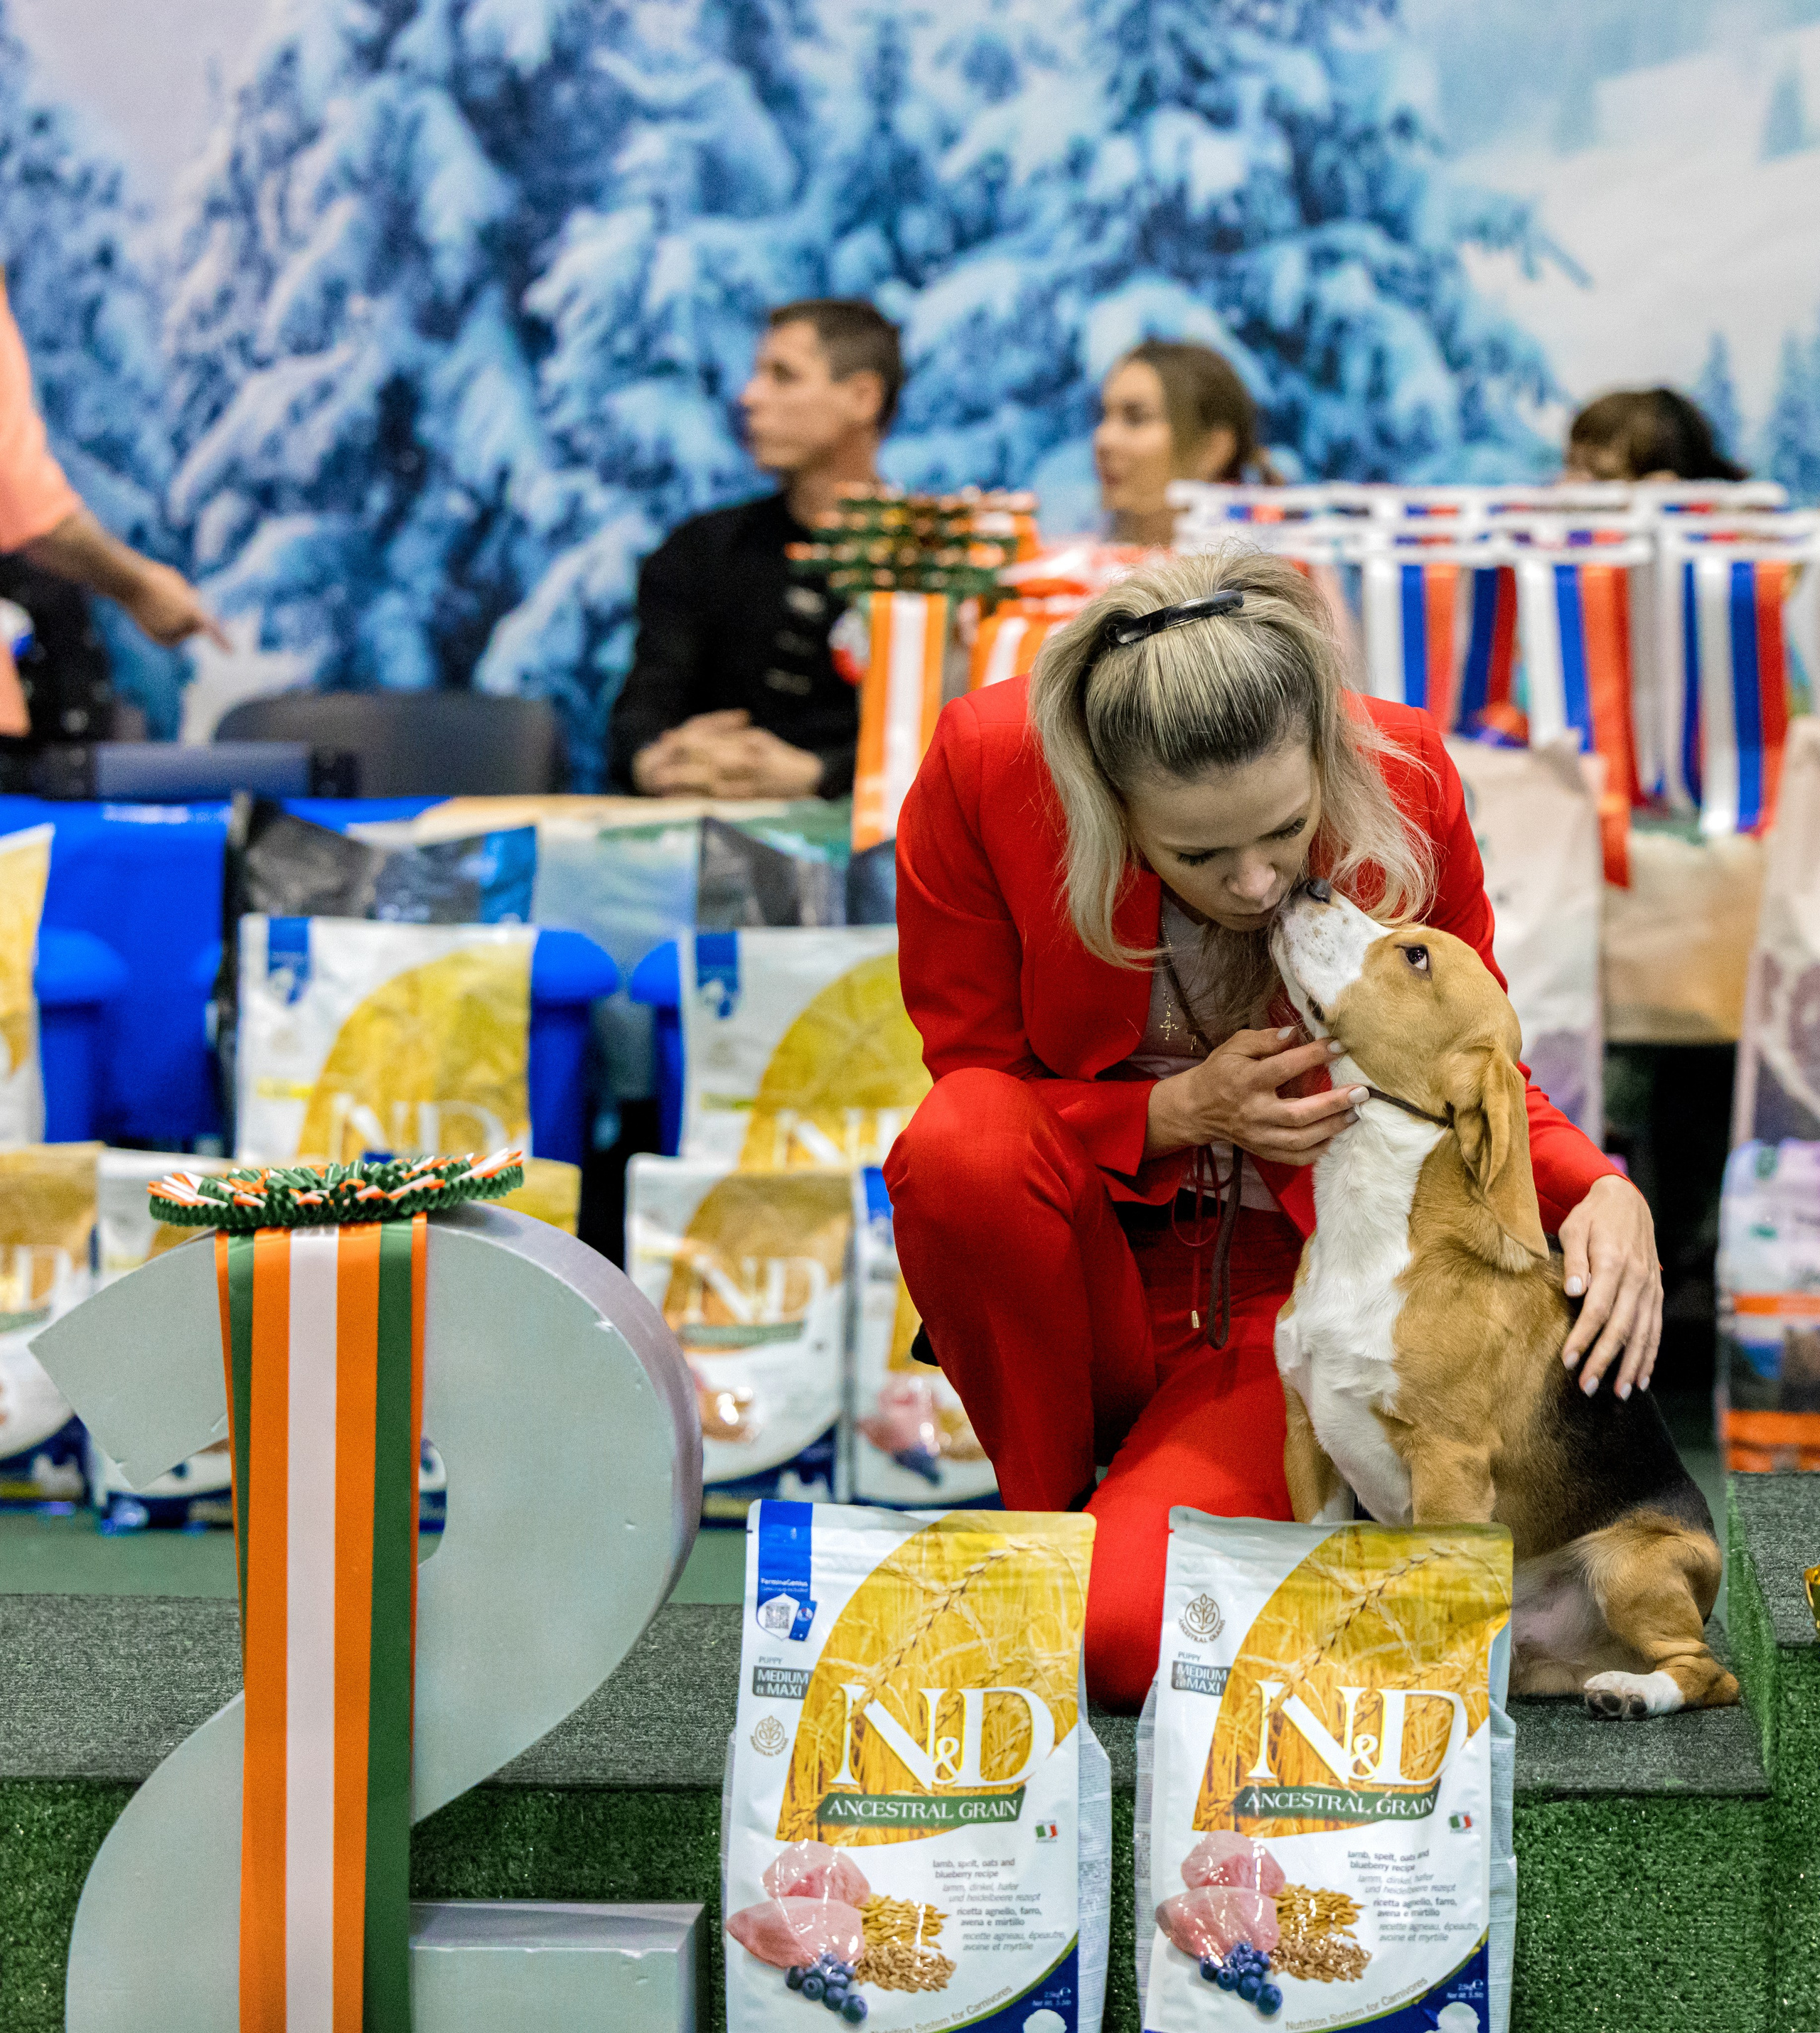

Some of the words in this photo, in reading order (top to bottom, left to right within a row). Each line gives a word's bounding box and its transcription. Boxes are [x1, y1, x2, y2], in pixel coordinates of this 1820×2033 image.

[759, 1656, 783, 1664] PUPPY
[1178, 1651, 1201, 1661] PUPPY
[756, 1668, 809, 1685] MEDIUM
[1177, 1663, 1227, 1682] MEDIUM
[767, 1682, 802, 1697] MAXI
[1186, 1676, 1221, 1695] MAXI
[828, 1683, 1055, 1790] N&D
[1246, 1680, 1468, 1785] N&D
[828, 1799, 955, 1819] ANCESTRAL
[958, 1799, 1018, 1818] GRAIN
[1244, 1791, 1372, 1814] ANCESTRAL
[1376, 1794, 1435, 1816] GRAIN
[958, 1860, 979, 1868] spelt,
[1348, 1850, 1371, 1859] lamb,
[1374, 1852, 1396, 1862] spelt,
[1350, 1861, 1389, 1871] blueberry
[1373, 1898, 1400, 1906] ricetta
[1435, 1897, 1457, 1906] farro,
[985, 1907, 1017, 1916] agnello,
[1020, 1906, 1042, 1915] farro,
[1410, 1908, 1440, 1916] mirtillo
[914, 2017, 950, 2033] System
[951, 2011, 965, 2021] for
[966, 1985, 1013, 2015] Carnivores
[1285, 2018, 1328, 2031] Nutrition
[1329, 2007, 1364, 2024] System
[1366, 2000, 1380, 2012] for
[1381, 1977, 1428, 2006] Carnivores
